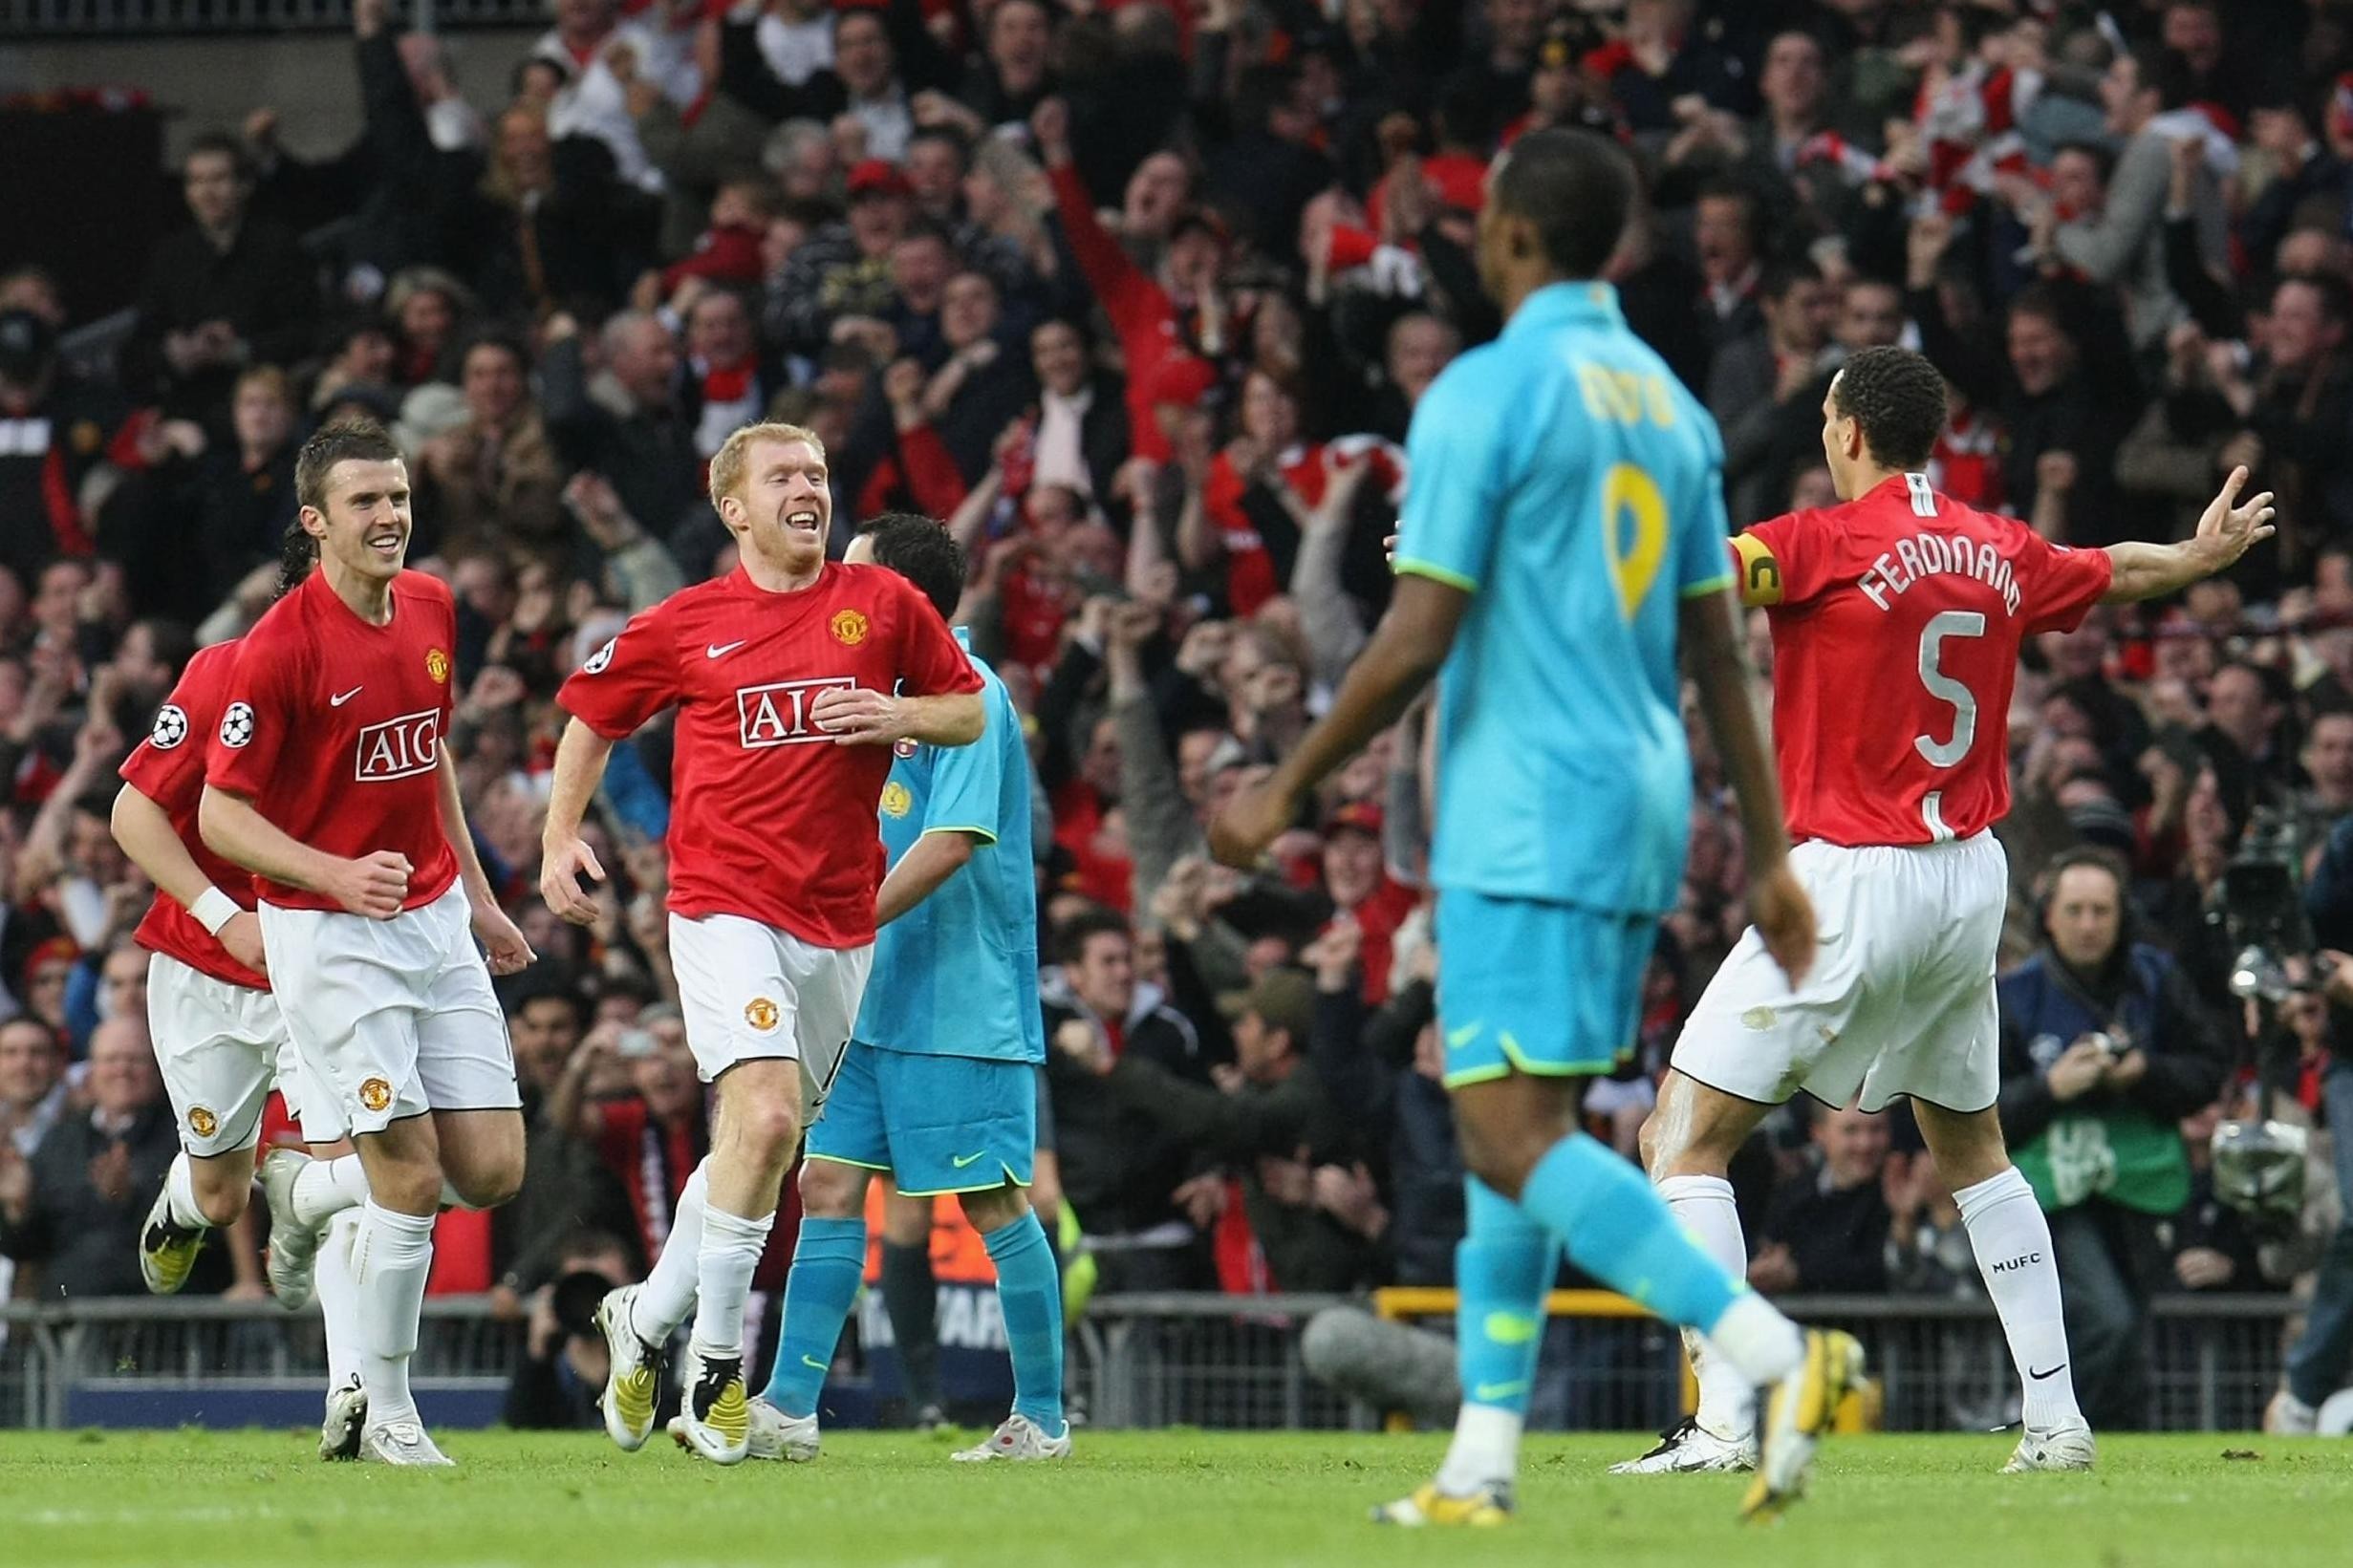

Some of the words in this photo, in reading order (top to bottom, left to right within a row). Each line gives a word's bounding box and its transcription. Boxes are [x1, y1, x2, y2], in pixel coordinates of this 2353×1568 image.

[1857, 533, 2021, 617] FERDINAND
[1914, 611, 1985, 767] 5
[362, 718, 437, 773] AIG
[1992, 1253, 2041, 1274] MUFC
